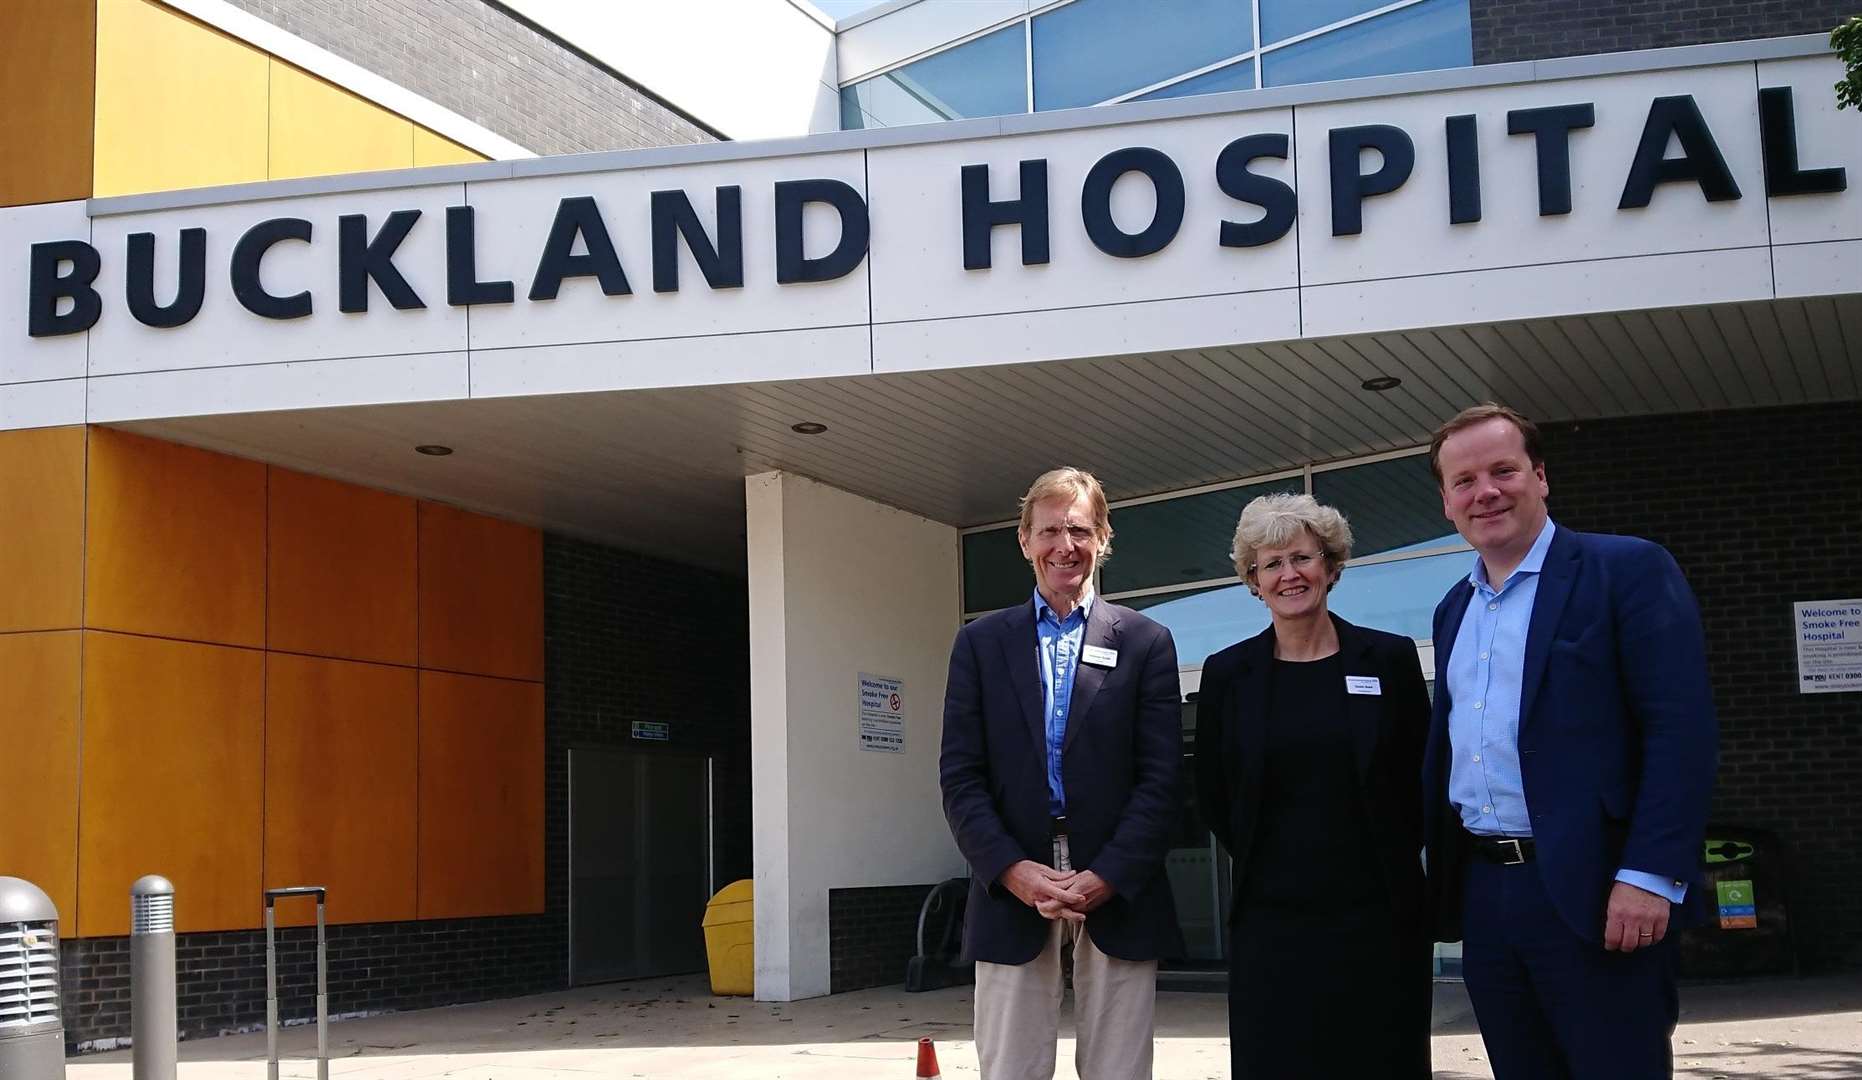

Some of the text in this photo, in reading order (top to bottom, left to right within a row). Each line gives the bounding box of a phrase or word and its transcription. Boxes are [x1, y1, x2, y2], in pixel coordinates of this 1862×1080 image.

[27, 86, 1847, 337] BUCKLAND HOSPITAL
[1801, 607, 1861, 618] Welcome to
[1802, 618, 1860, 629] Smoke Free
[1803, 630, 1845, 641] Hospital
[862, 680, 882, 689] Welcome
